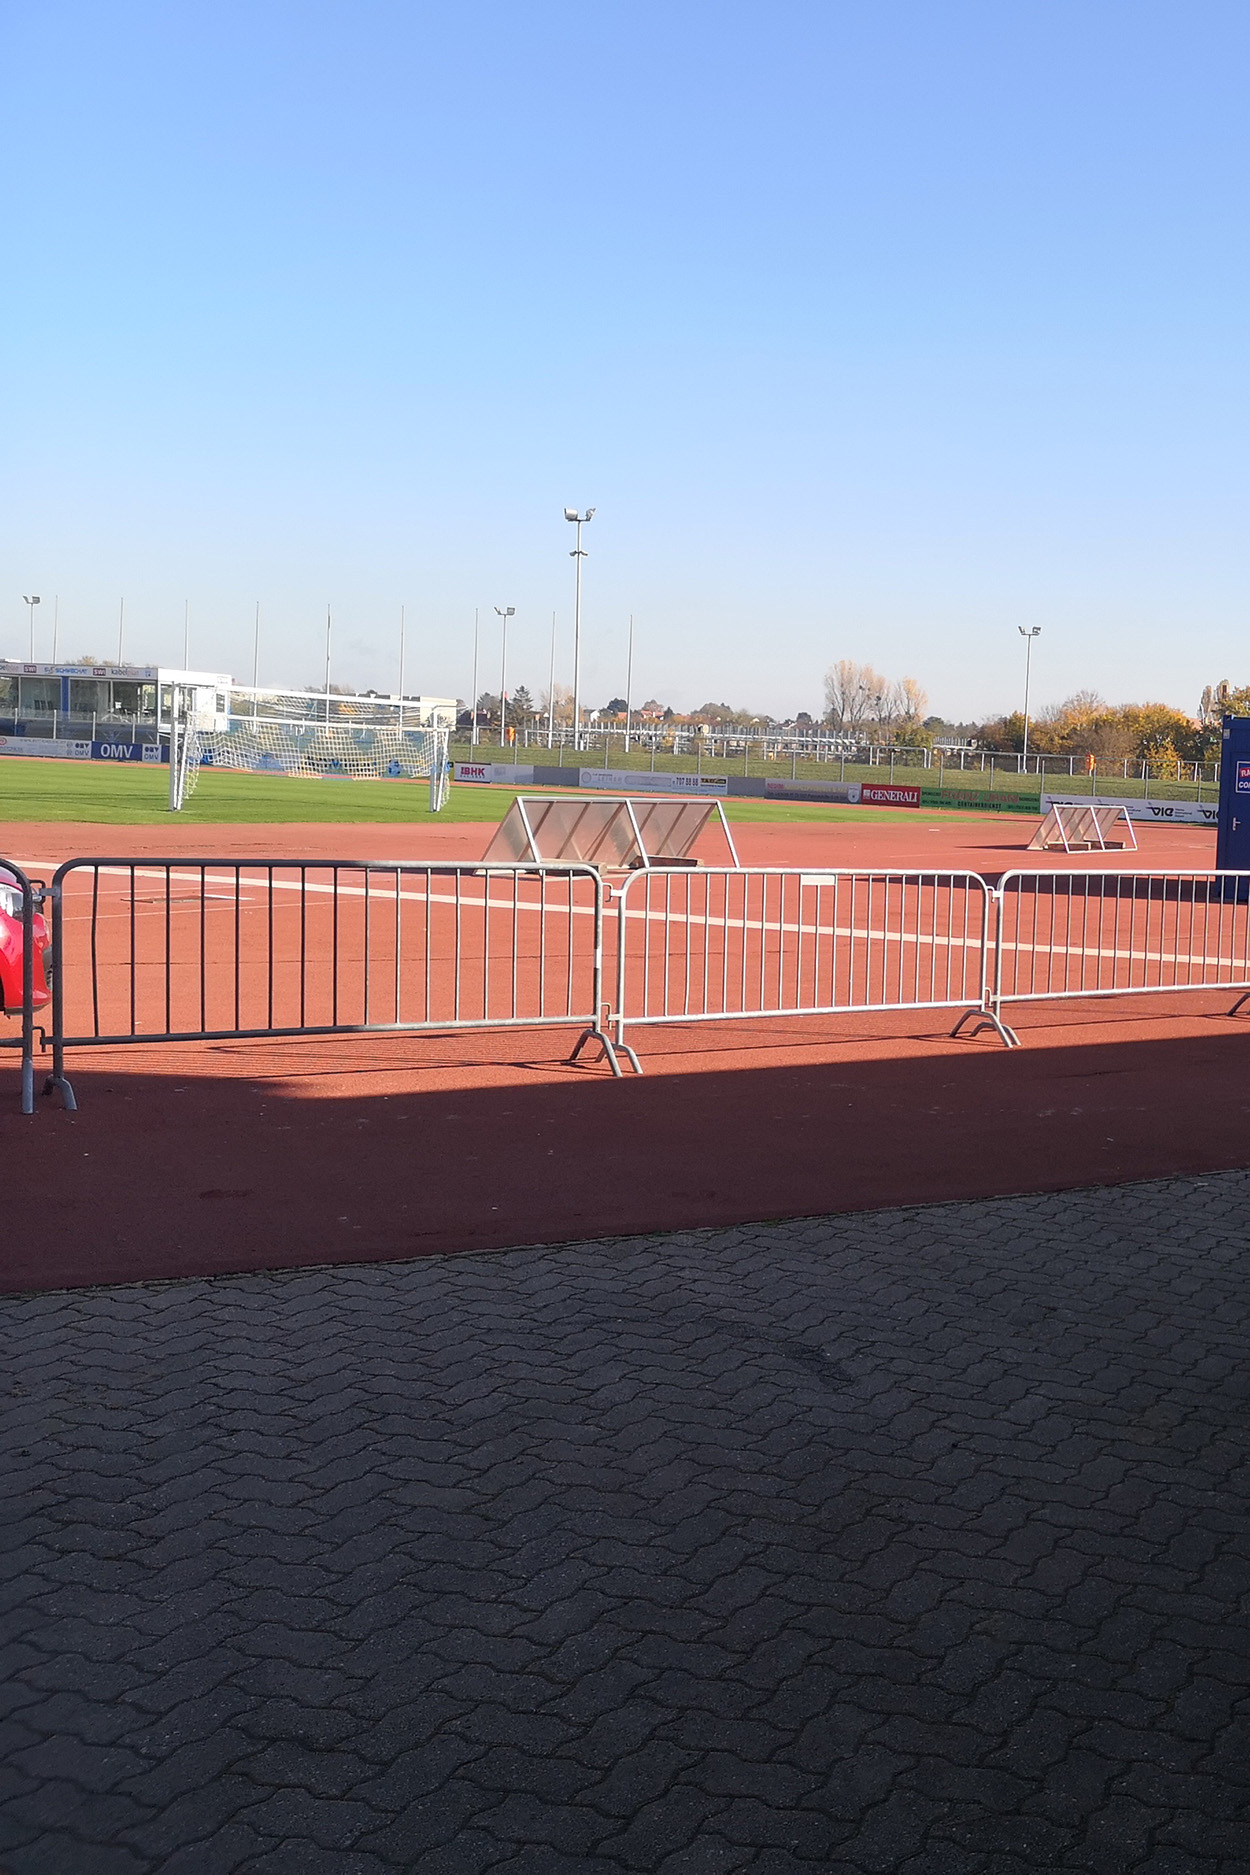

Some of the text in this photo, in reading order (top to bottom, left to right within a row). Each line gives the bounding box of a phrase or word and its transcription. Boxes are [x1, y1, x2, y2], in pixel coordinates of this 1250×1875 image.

[100, 743, 133, 759] OMV
[461, 766, 485, 776] IBHK
[871, 789, 918, 803] GENERALI
